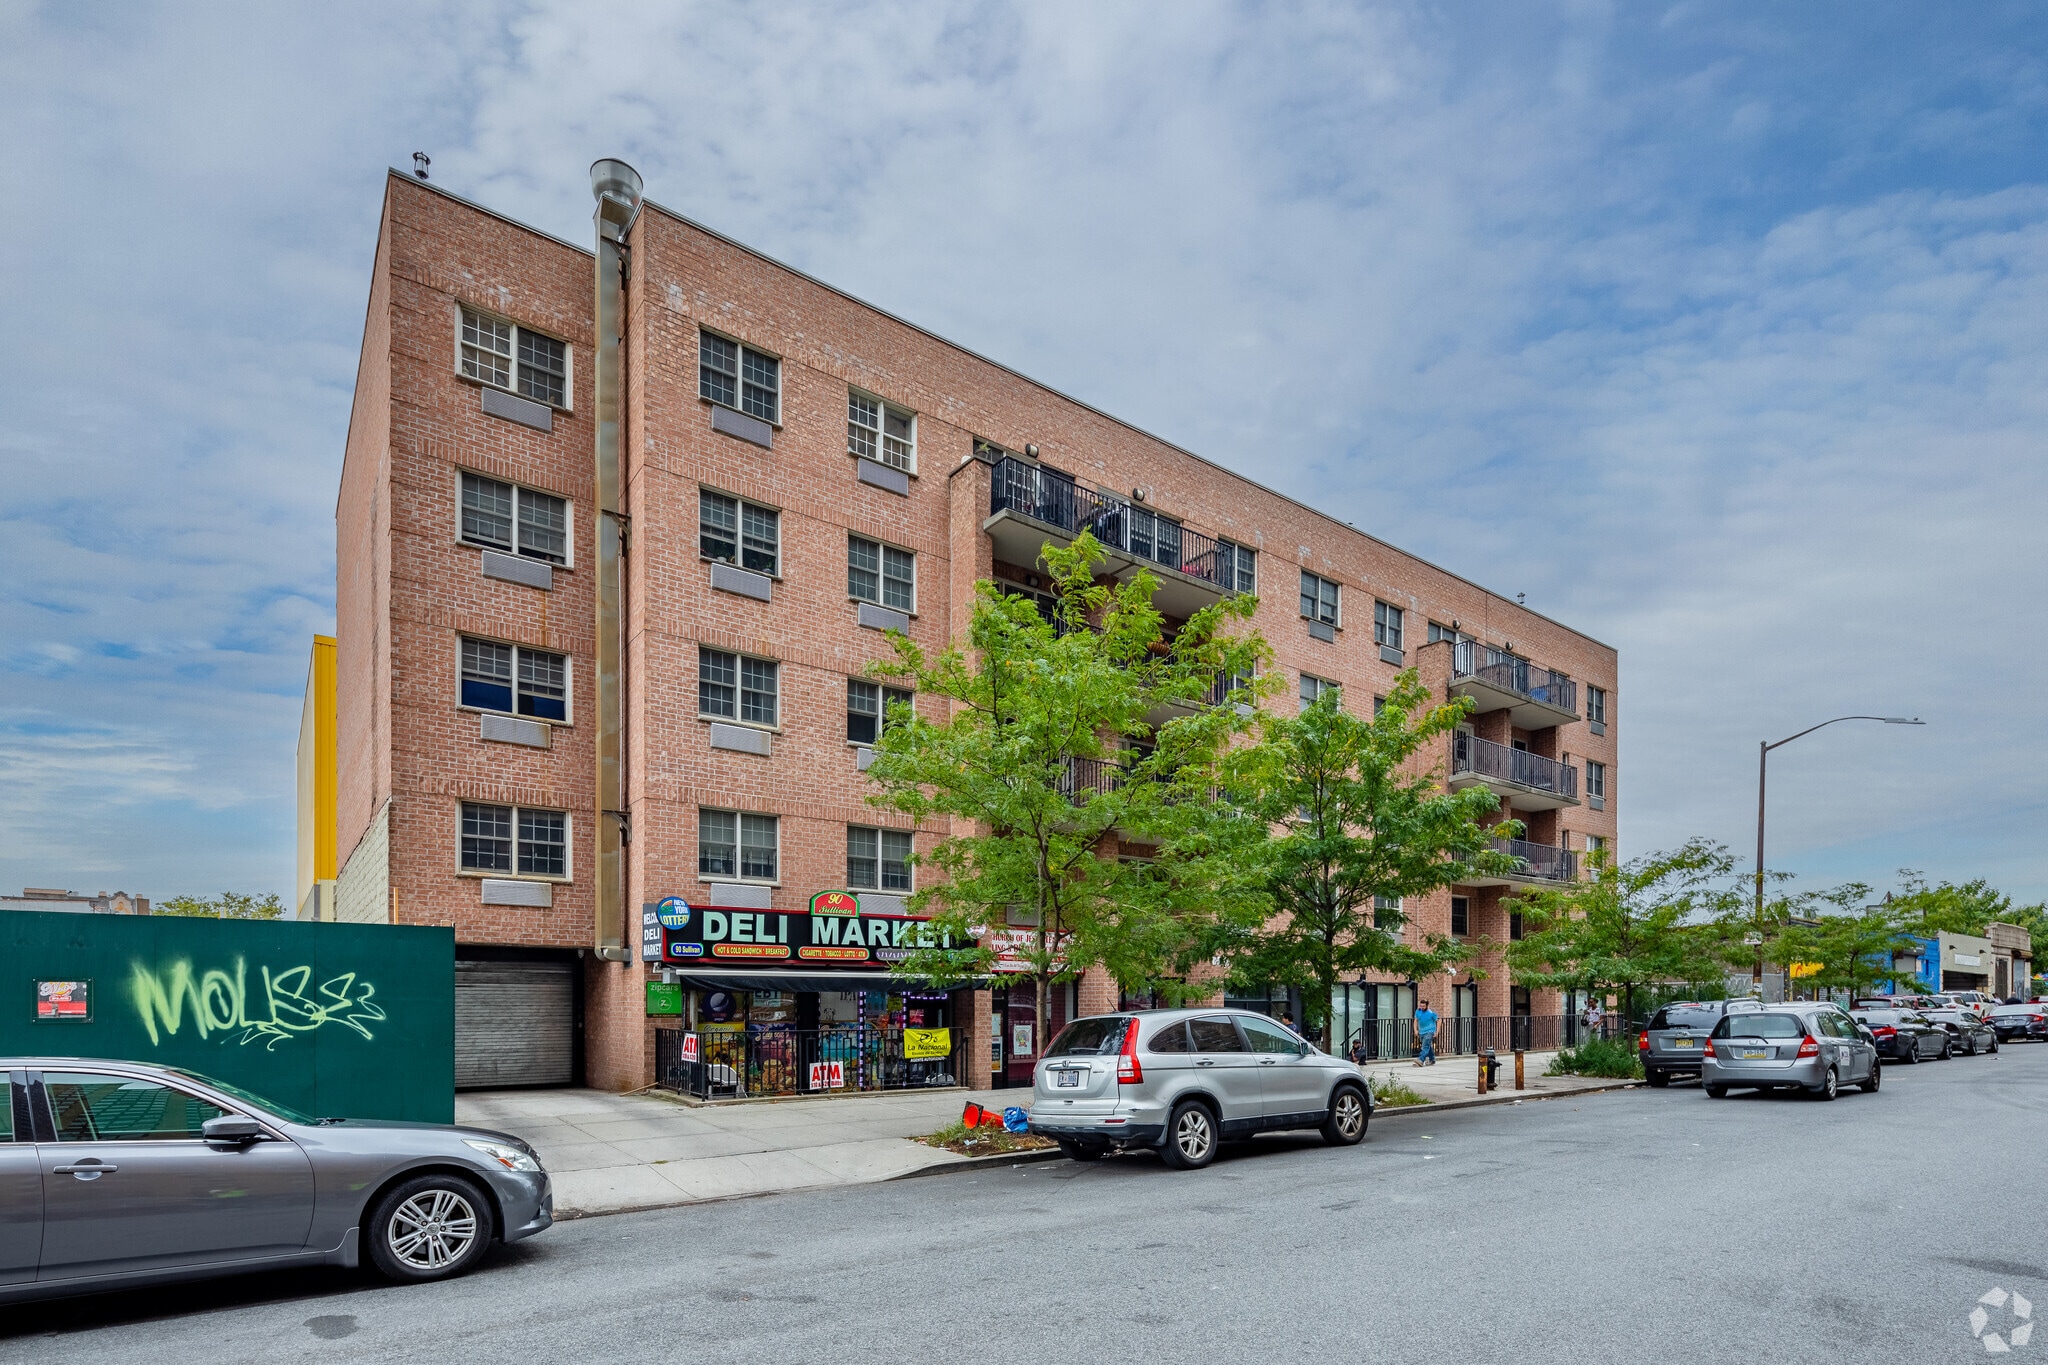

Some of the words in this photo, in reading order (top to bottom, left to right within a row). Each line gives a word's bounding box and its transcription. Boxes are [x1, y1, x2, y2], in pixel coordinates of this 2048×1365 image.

[828, 893, 843, 904] 90
[674, 905, 688, 914] YORK
[818, 905, 852, 915] Sullivan
[660, 914, 689, 926] LOTTERY
[703, 911, 788, 944] DELI
[644, 928, 660, 941] DELI
[1015, 934, 1024, 942] OF
[643, 943, 662, 956] MARKET
[650, 983, 679, 993] zipcars
[918, 1043, 947, 1051] Nacional
[811, 1064, 841, 1082] ATM
